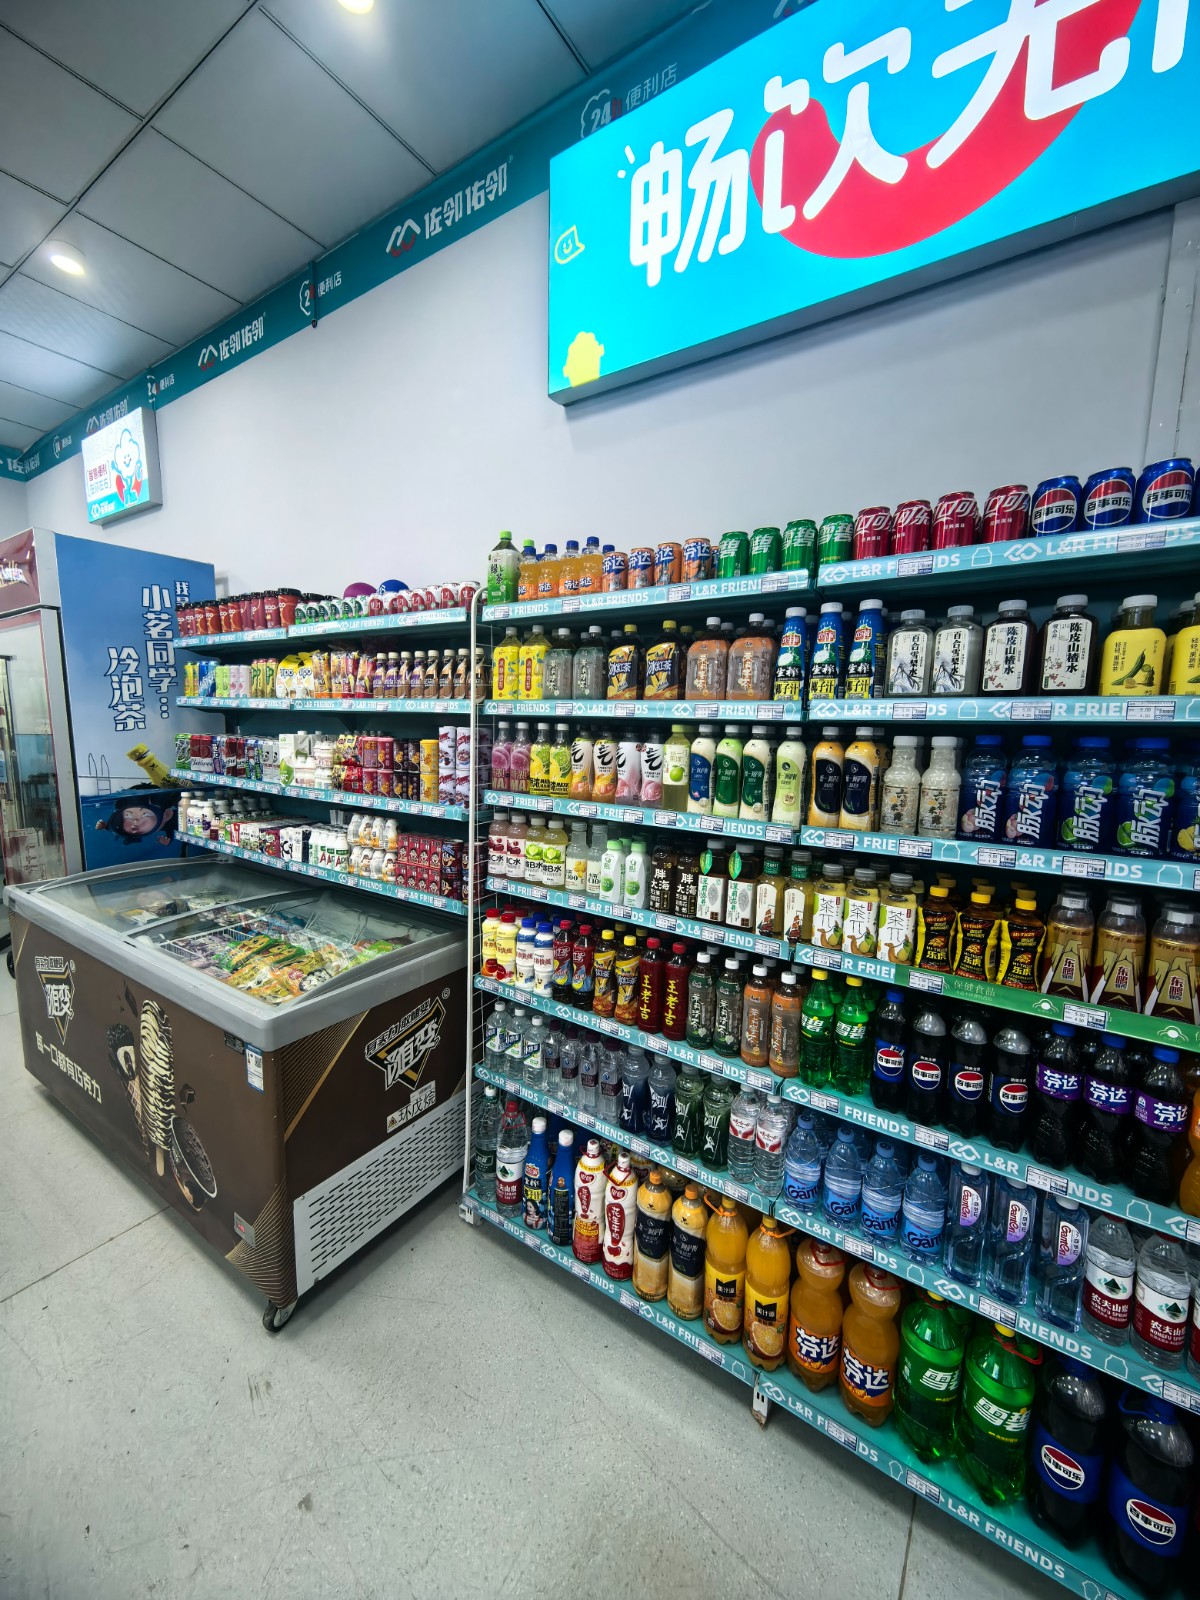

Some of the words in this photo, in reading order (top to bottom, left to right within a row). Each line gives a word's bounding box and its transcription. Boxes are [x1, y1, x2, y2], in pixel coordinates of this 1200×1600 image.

[625, 63, 678, 111] 便利店
[629, 0, 1196, 287] 畅饮无
[424, 163, 508, 239] 佐邻佑邻
[318, 271, 342, 298] 便利店
[219, 315, 264, 361] 佐邻佑邻
[1087, 496, 1131, 513] 百事可乐
[1147, 488, 1192, 504] 百事可乐
[1034, 504, 1075, 520] 百事可乐
[852, 564, 882, 579] L&R
[607, 591, 649, 605] FRIENDS
[696, 584, 718, 598] L&R
[515, 603, 549, 616] FRIENDS
[909, 634, 919, 676] 百合雪梨水
[952, 631, 962, 675] 百合雪梨水
[1004, 626, 1018, 674] 陈皮山楂水
[1066, 622, 1082, 673] 陈皮山楂水
[608, 662, 632, 677] 冰红茶
[648, 660, 673, 677] 冰红茶
[105, 645, 147, 732] 冷泡茶
[517, 704, 550, 713] FRIENDS
[587, 704, 605, 713] L&R
[843, 705, 874, 716] L&R
[1016, 783, 1049, 839] 脉动
[1072, 785, 1108, 843] 脉动
[1131, 787, 1170, 849] 脉动
[722, 822, 763, 836] RIENDS
[864, 836, 898, 851] FRIE
[585, 899, 602, 909] L&R
[926, 950, 947, 960] 乐虎
[963, 955, 982, 967] 乐虎
[1013, 966, 1032, 976] 乐虎
[1062, 956, 1076, 976] 东鹏
[1114, 965, 1130, 985] 东鹏
[953, 979, 996, 997] 保健食品
[1168, 975, 1185, 996] 东鹏
[640, 974, 652, 1019] 王老吉
[665, 979, 679, 1026] 王老吉
[572, 1011, 589, 1025] L&R
[836, 1021, 867, 1039] 雪碧
[674, 1049, 694, 1060] L&R
[36, 1031, 102, 1103] 每一口都有巧克力
[490, 1075, 505, 1088] L&R
[1044, 1069, 1078, 1090] 芬达
[1090, 1081, 1127, 1103] 芬达
[844, 1106, 910, 1137] FRIENDS
[1154, 1102, 1188, 1122] 芬达
[595, 1122, 630, 1145] RIENDS
[984, 1152, 1018, 1174] L&R
[805, 1220, 831, 1240] L&R
[1091, 1292, 1129, 1312] 农夫山泉
[655, 1314, 676, 1333] L&R
[796, 1328, 838, 1358] 芬达
[1018, 1313, 1092, 1360] RIENDS
[844, 1347, 890, 1391] 芬达
[788, 1398, 813, 1421] L&R
[973, 1397, 1031, 1431] 雪碧
[1043, 1453, 1083, 1484] 百事可乐
[1128, 1504, 1175, 1535] 百事可乐
[948, 1500, 980, 1526] L&R
[985, 1521, 1066, 1580] FRIENDS
